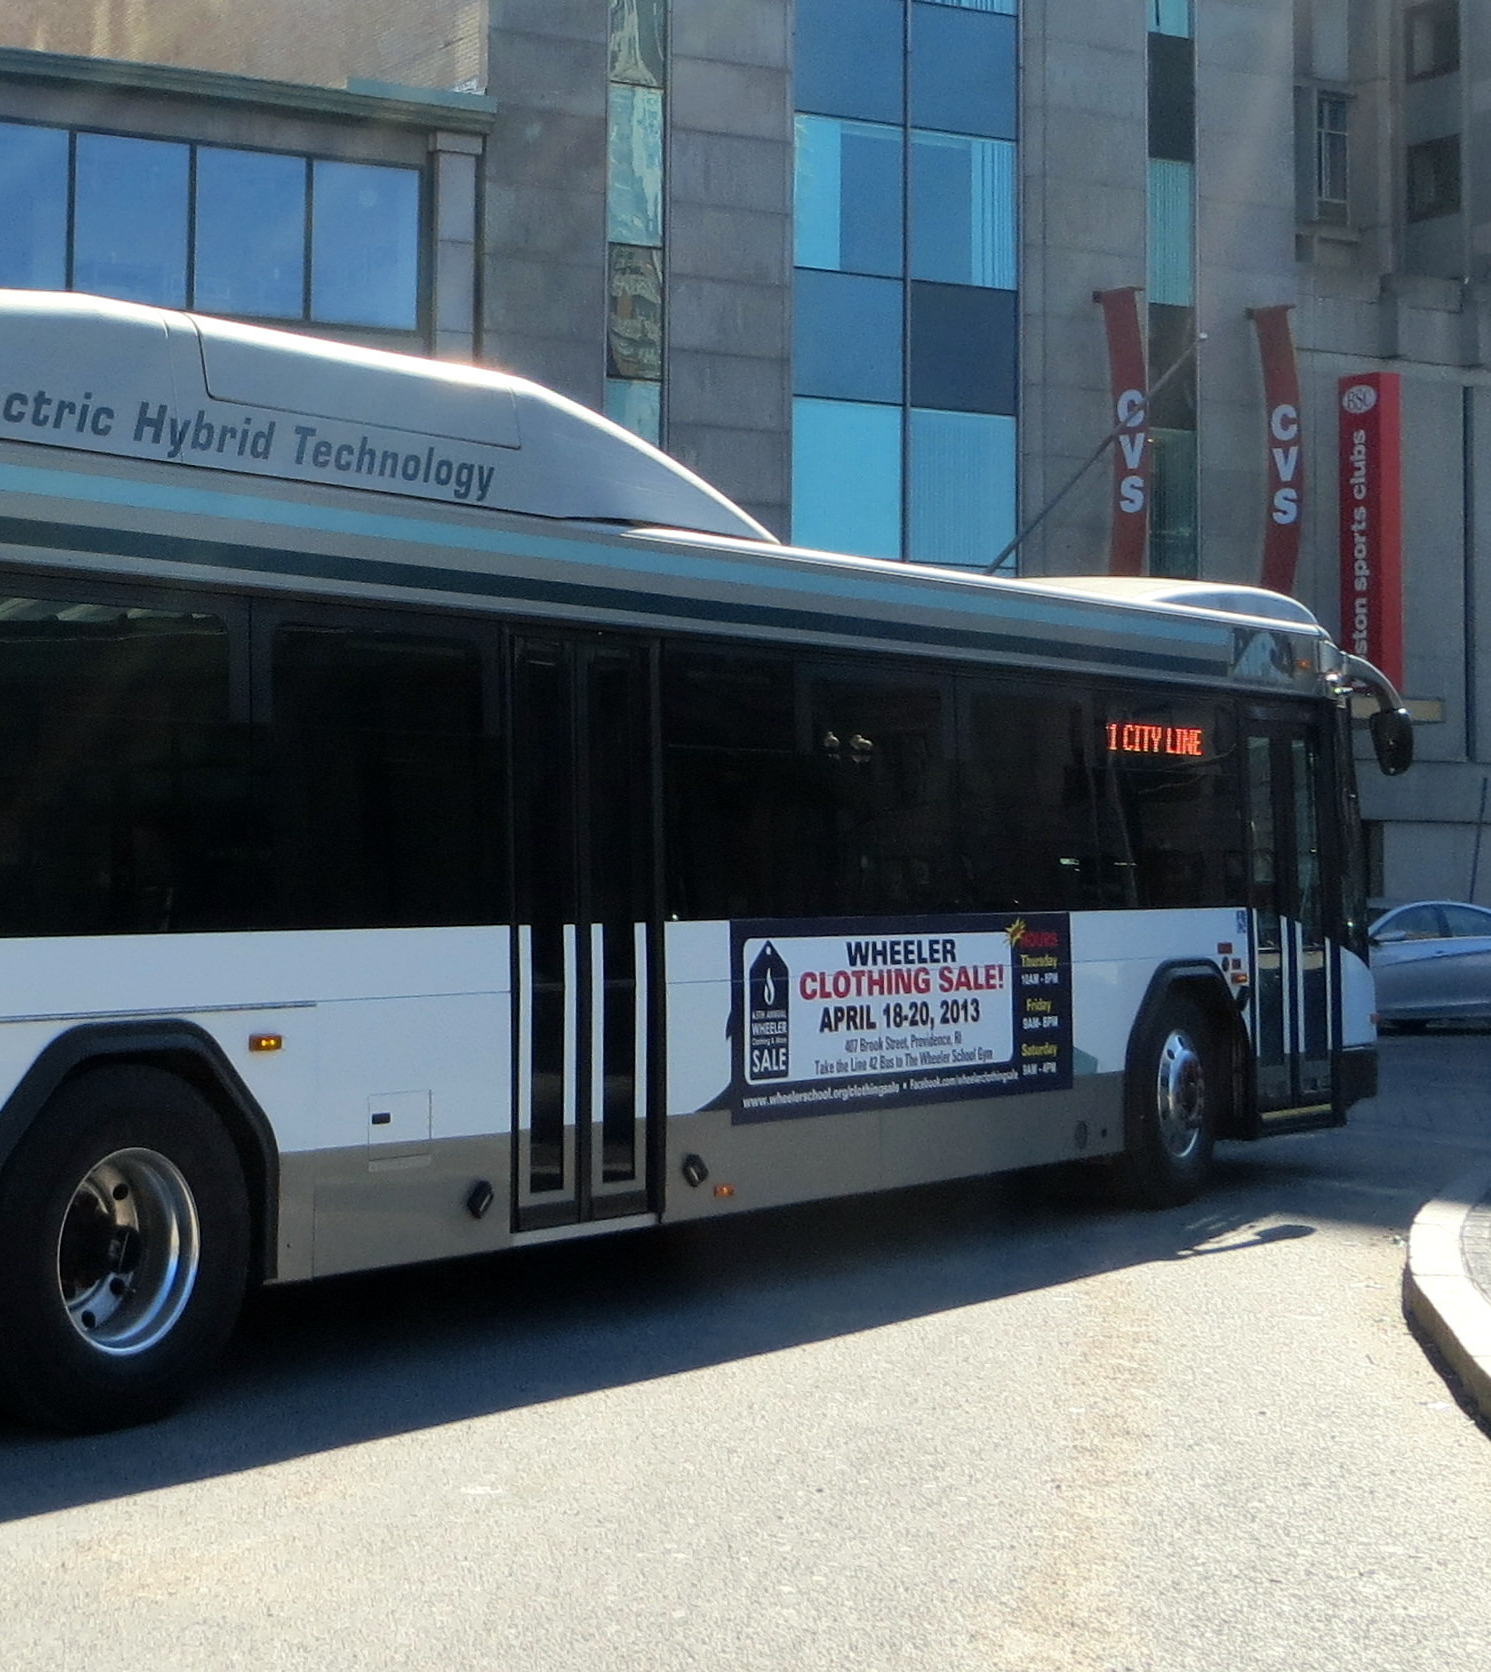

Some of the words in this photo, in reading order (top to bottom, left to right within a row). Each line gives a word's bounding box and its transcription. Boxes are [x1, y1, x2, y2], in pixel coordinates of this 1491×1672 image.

[133, 401, 276, 461] Hybrid
[292, 425, 495, 501] Technology
[1117, 389, 1145, 513] CVS
[1271, 404, 1299, 524] CVS
[1350, 429, 1366, 500] clubs
[1351, 506, 1370, 591] sports
[1122, 724, 1162, 752] CITY
[1166, 728, 1202, 755] LINE
[846, 938, 957, 967] WHEELER
[1020, 954, 1057, 969] Thursday
[799, 967, 931, 1000] CLOTHING
[938, 964, 1004, 993] SALE!
[819, 1004, 877, 1033] APRIL
[883, 1000, 935, 1030] 18-20,
[940, 998, 981, 1025] 2013
[1026, 998, 1052, 1013] Friday
[751, 1021, 787, 1036] WHEELER
[859, 1037, 883, 1052] Brook
[1021, 1042, 1057, 1057] Saturday
[752, 1048, 787, 1073] SALE
[814, 1060, 834, 1075] Take
[836, 1058, 849, 1073] the
[850, 1057, 867, 1072] Line
[869, 1056, 878, 1070] 42
[880, 1055, 894, 1069] Bus
[896, 1054, 904, 1068] to
[905, 1053, 918, 1067] The
[919, 1051, 951, 1066] Wheeler
[952, 1048, 977, 1064] School
[978, 1046, 993, 1063] Gym
